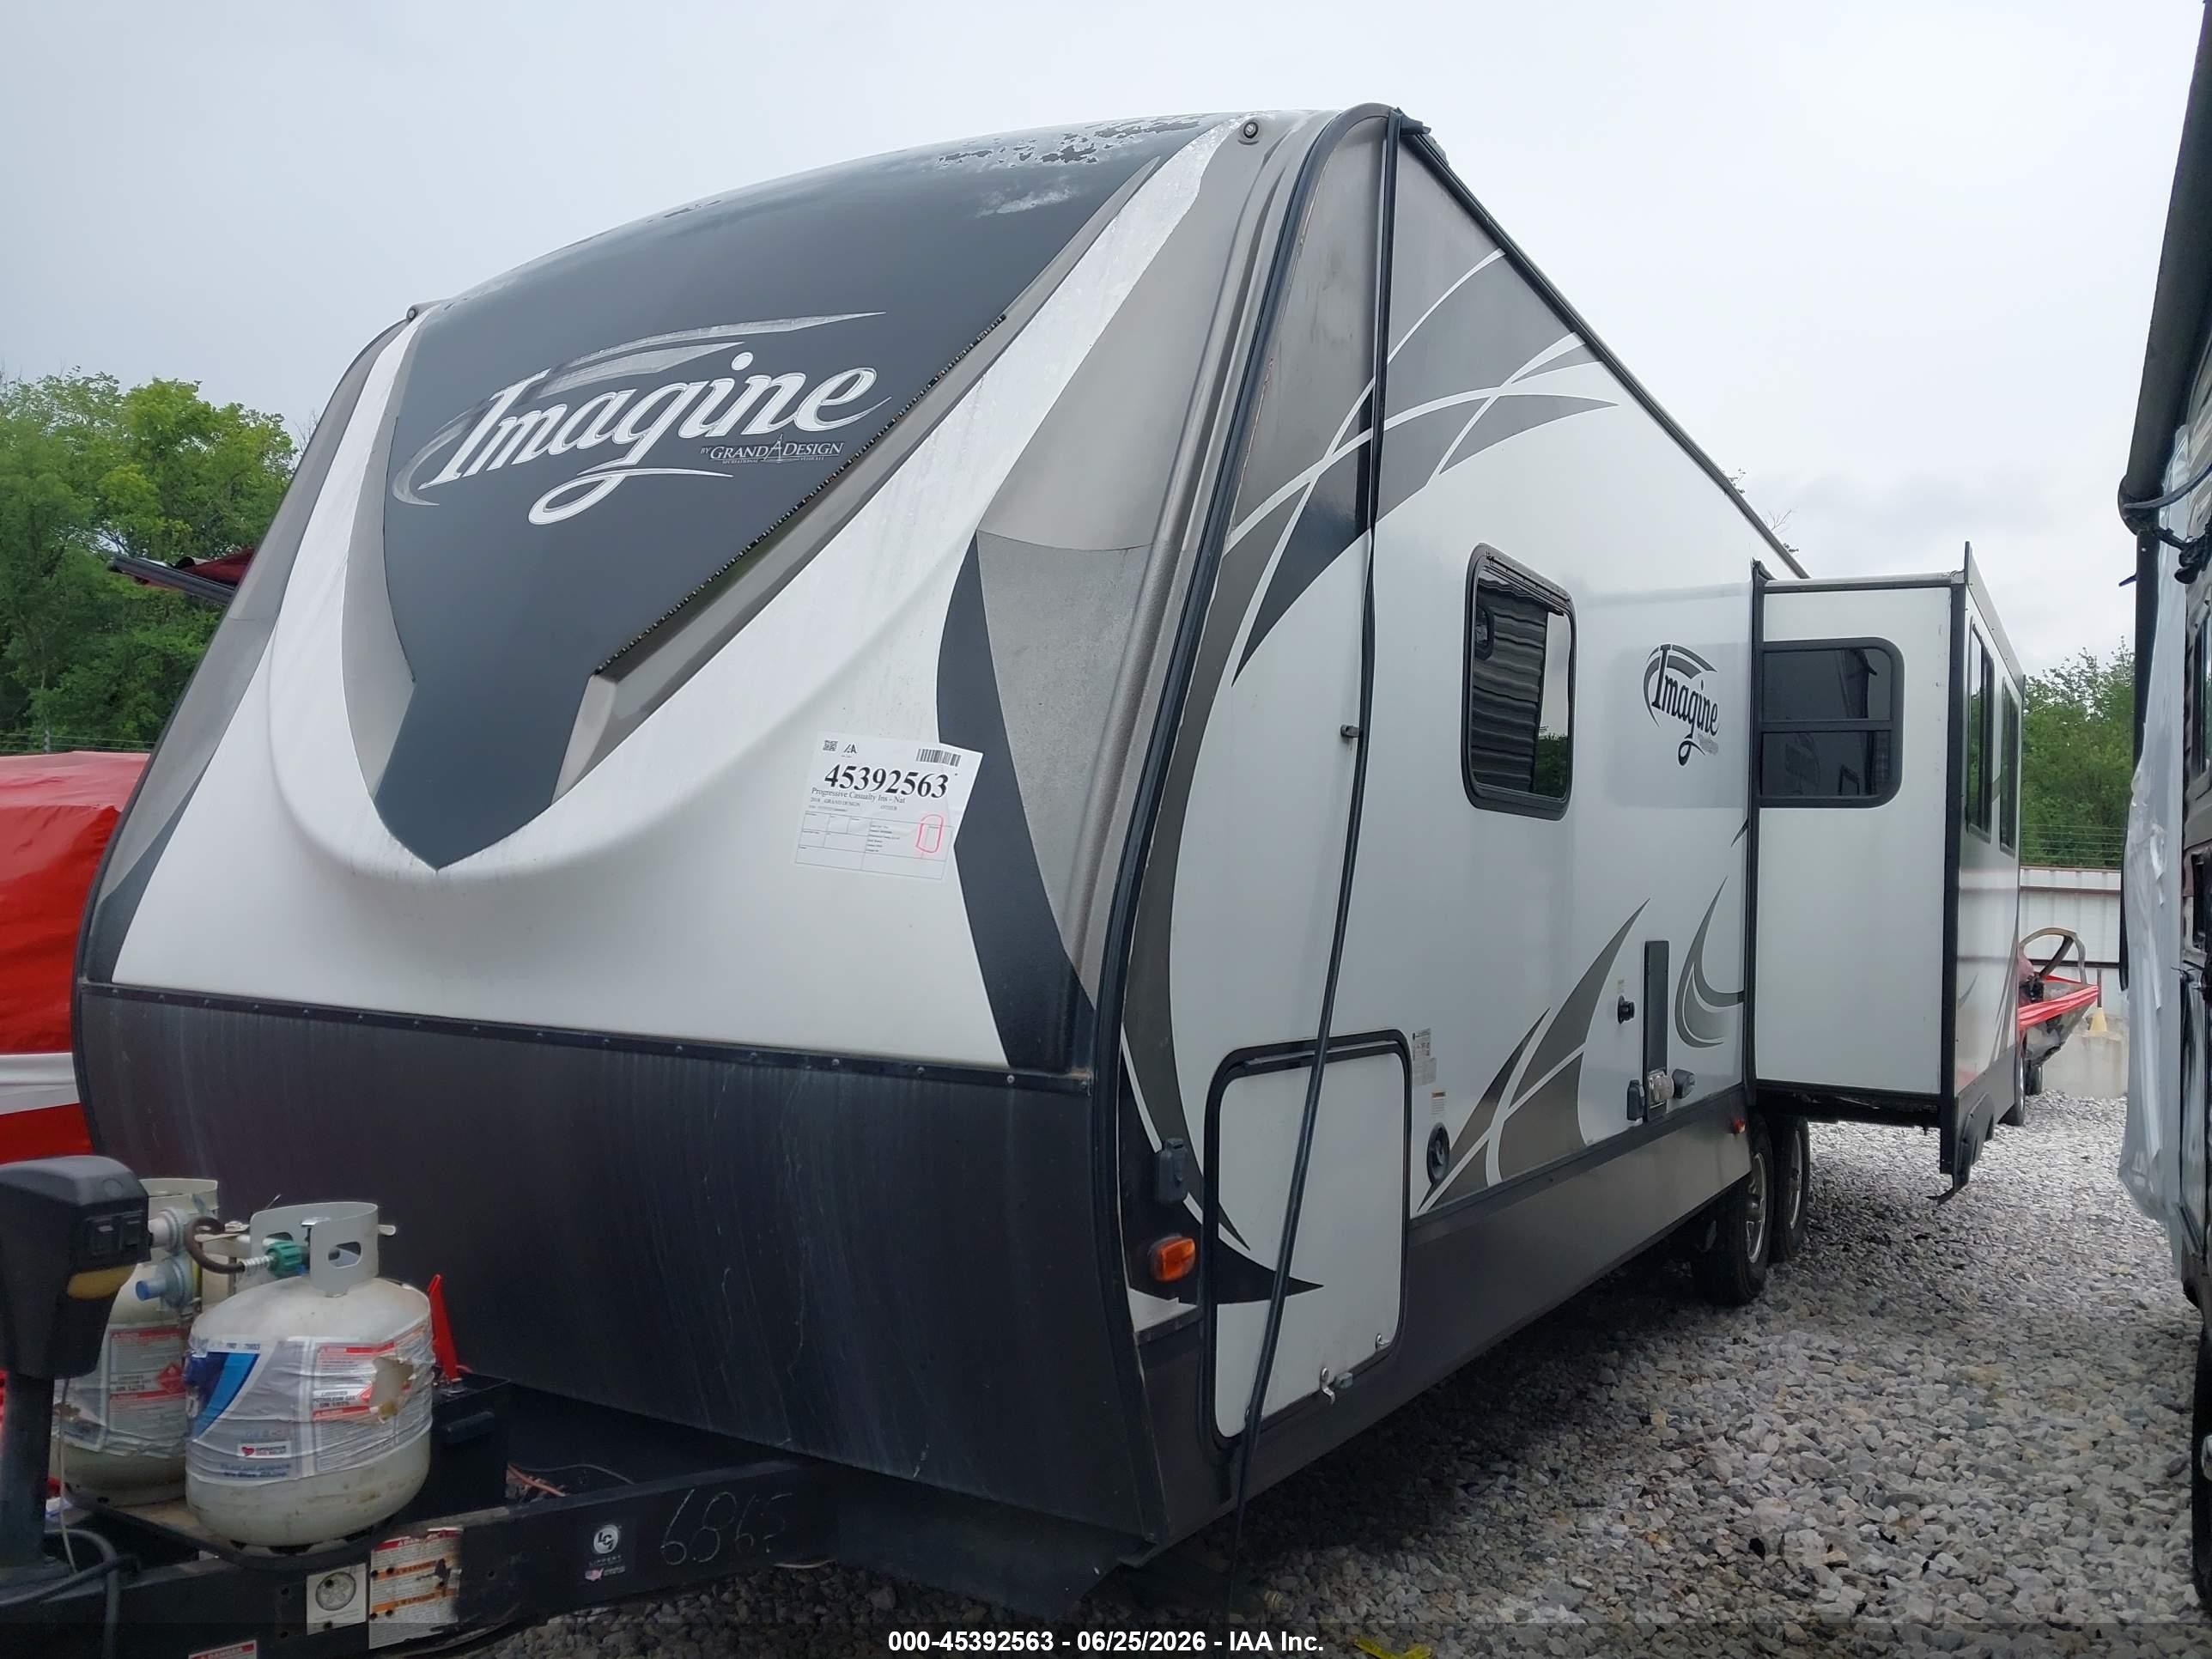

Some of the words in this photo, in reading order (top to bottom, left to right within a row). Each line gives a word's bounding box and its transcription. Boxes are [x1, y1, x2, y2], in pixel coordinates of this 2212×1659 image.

[418, 351, 892, 526] Imagine
[709, 445, 769, 460] GRAND
[782, 441, 844, 456] DESIGN
[1651, 644, 1719, 766] Imagine
[811, 787, 848, 798] Progressive
[848, 791, 876, 802] Casualty
[824, 763, 949, 799] 45392563
